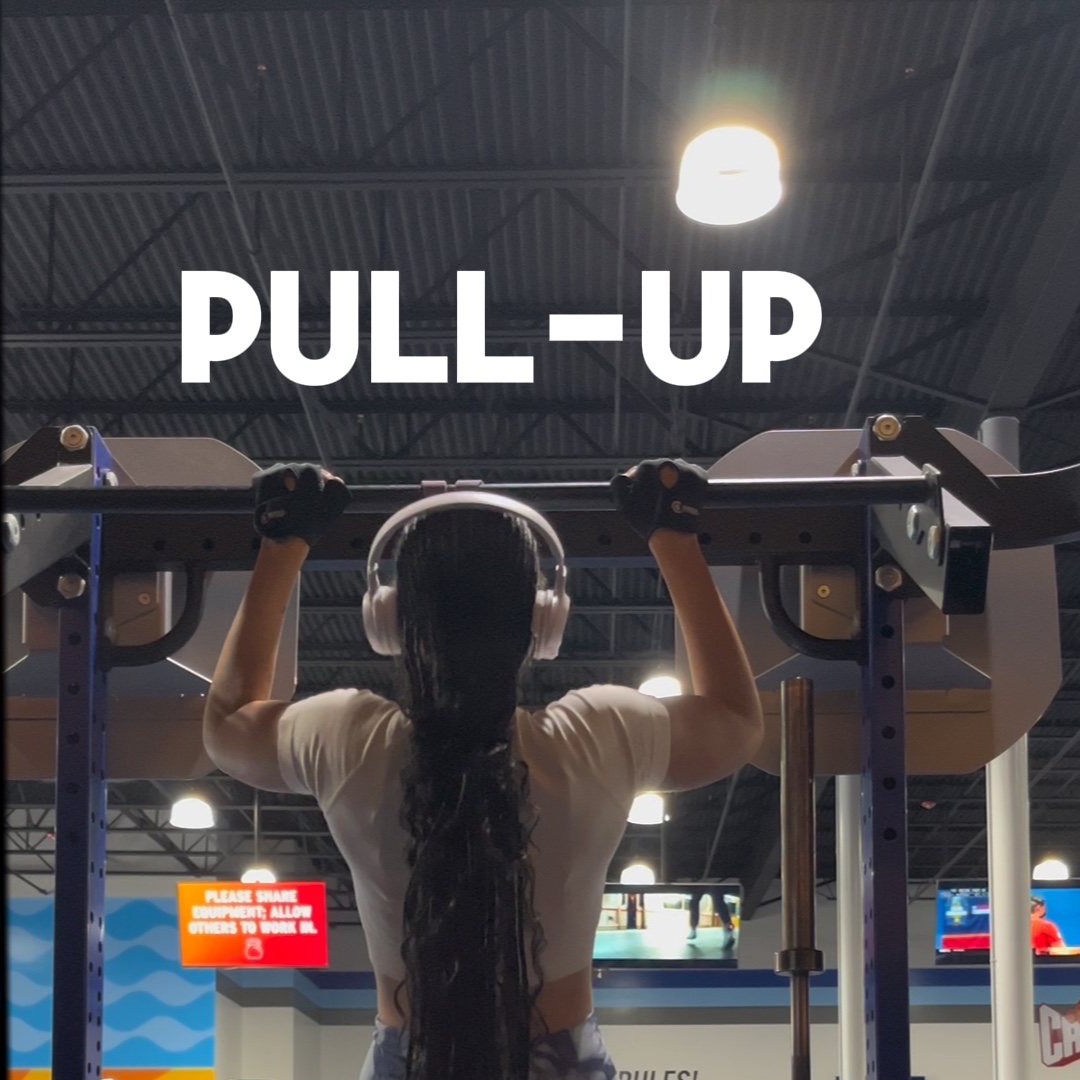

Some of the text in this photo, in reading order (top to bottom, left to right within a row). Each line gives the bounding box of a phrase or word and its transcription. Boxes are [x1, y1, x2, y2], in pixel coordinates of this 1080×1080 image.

[205, 889, 298, 903] PLEASE SHARE
[270, 905, 312, 919] ALLOW
[188, 921, 237, 935] OTHERS
[240, 921, 257, 934] TO
[260, 921, 297, 934] WORK
